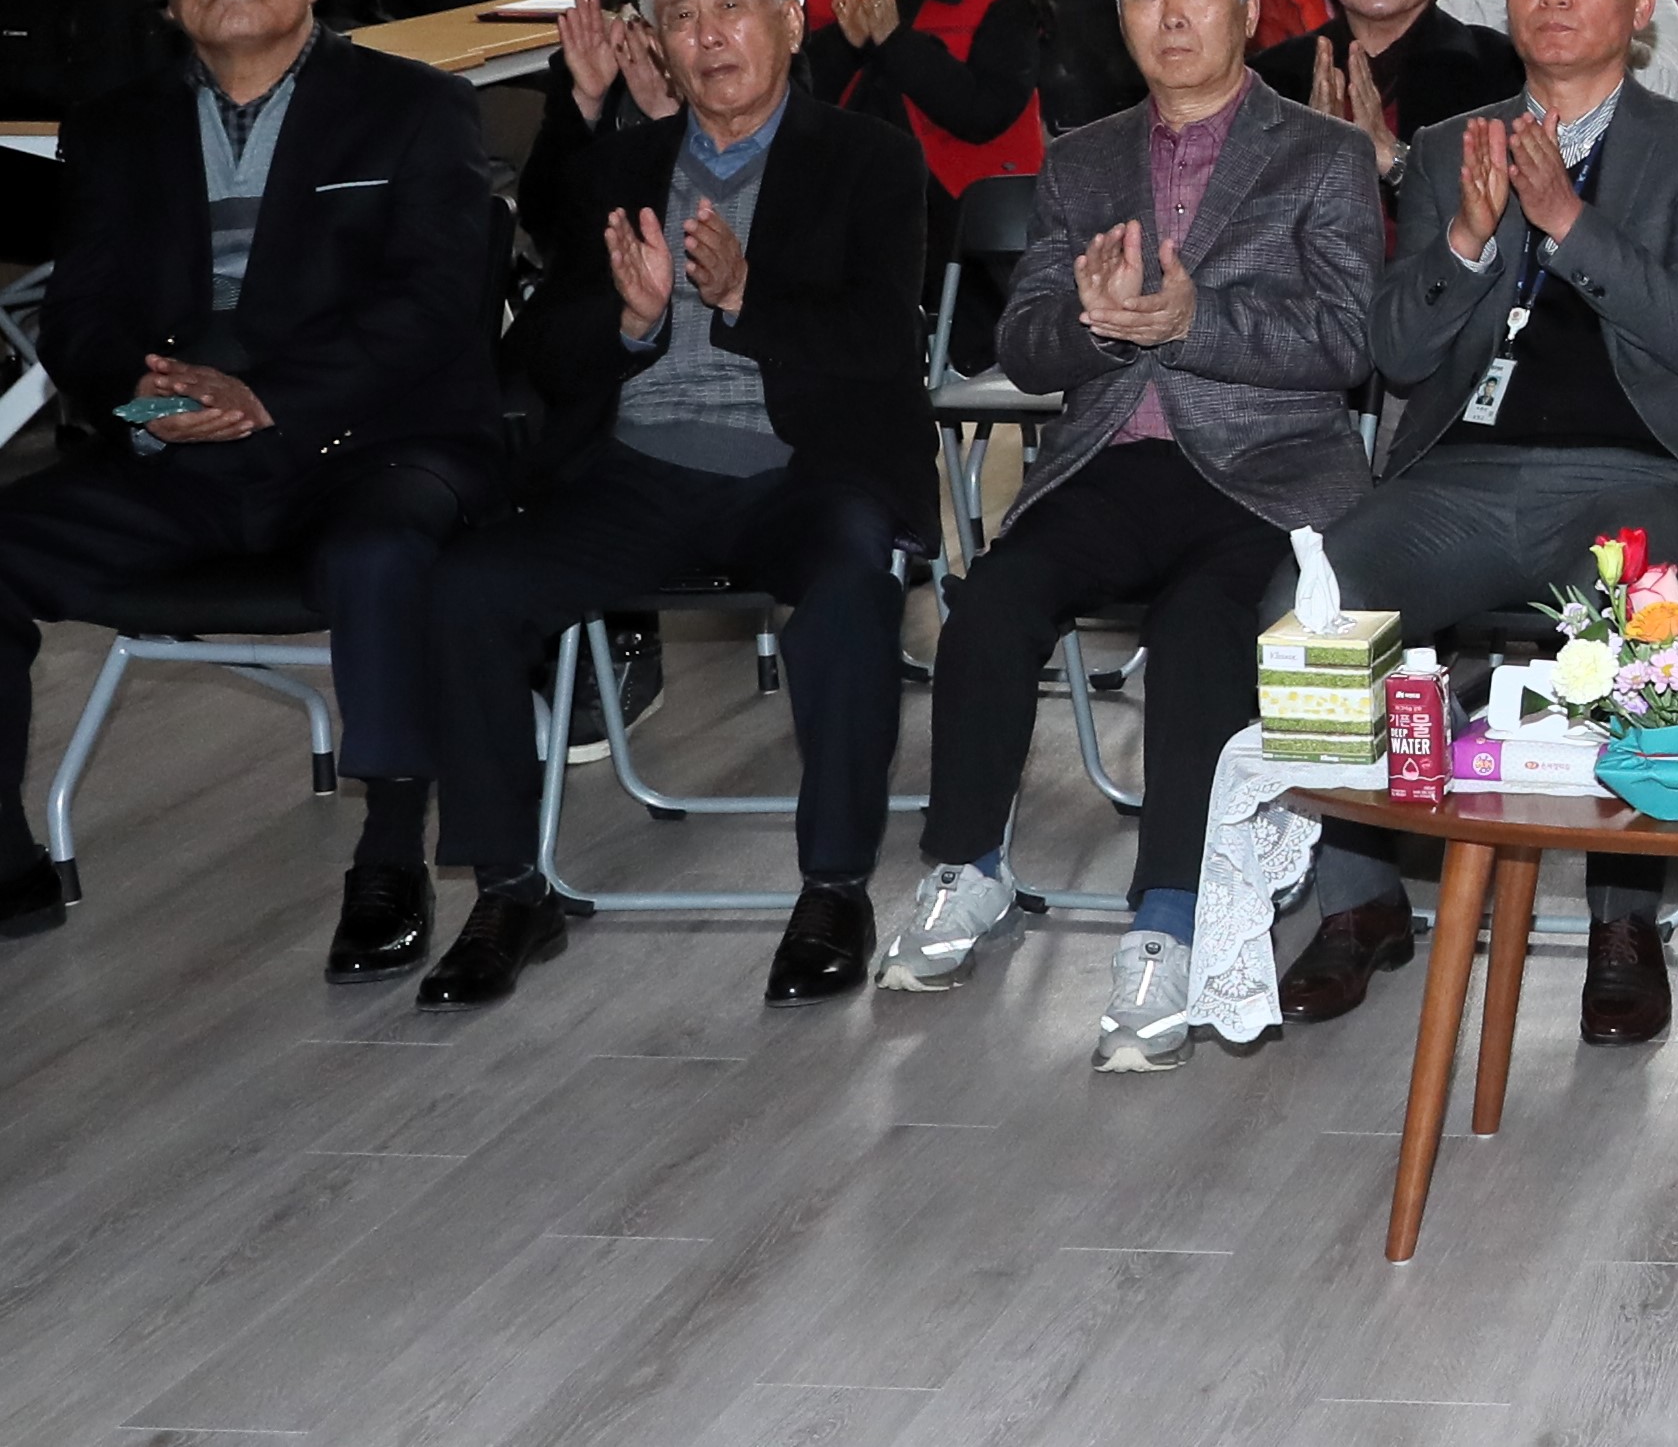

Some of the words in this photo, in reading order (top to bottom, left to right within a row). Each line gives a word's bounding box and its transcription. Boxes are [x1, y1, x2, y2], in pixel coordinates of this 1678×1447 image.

[1389, 714, 1411, 728] 기픈
[1411, 713, 1432, 738] 물
[1390, 728, 1408, 738] DEEP
[1391, 738, 1431, 755] WATER
